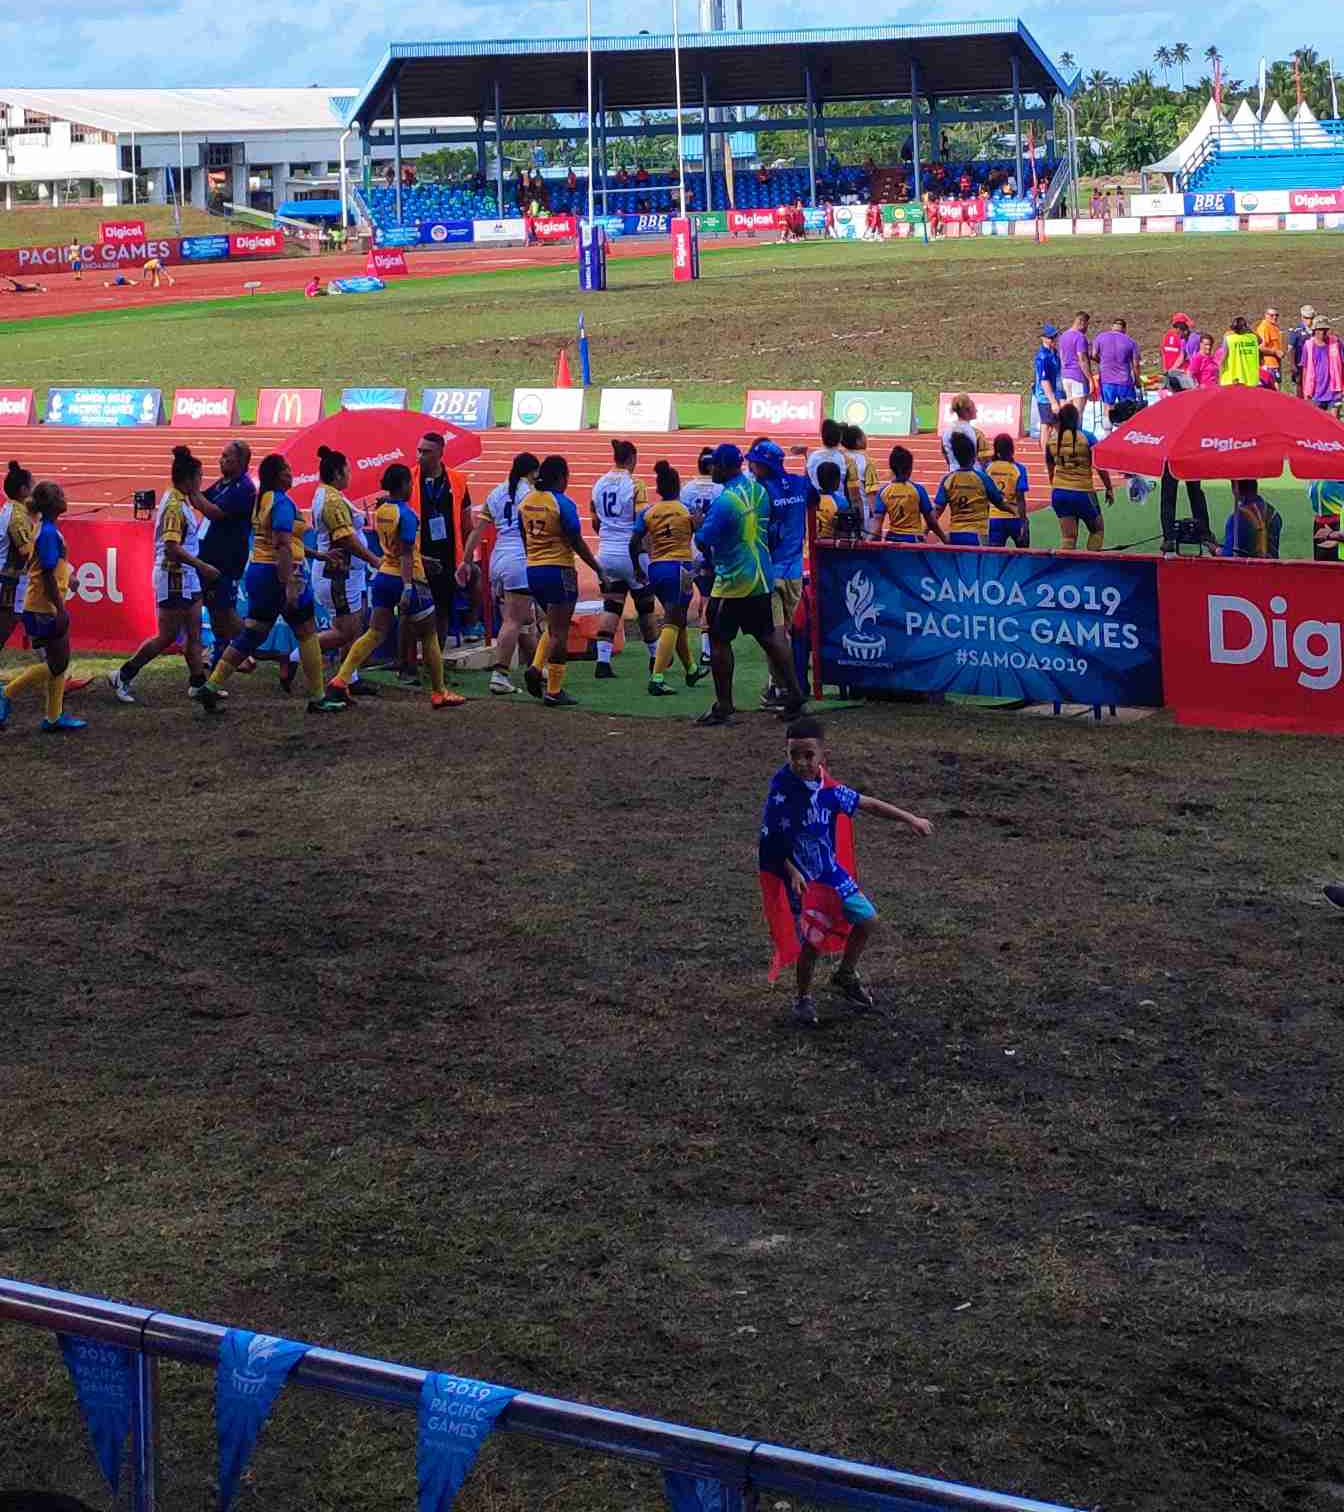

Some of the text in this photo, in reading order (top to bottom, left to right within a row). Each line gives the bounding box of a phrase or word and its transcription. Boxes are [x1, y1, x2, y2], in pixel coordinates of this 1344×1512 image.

[1194, 194, 1224, 211] BBE
[1294, 194, 1337, 208] Digicel
[735, 212, 774, 227] Digicel
[105, 224, 144, 240] Digicel
[236, 235, 276, 250] Digicel
[102, 241, 171, 261] GAMES
[375, 254, 404, 269] Digicel
[176, 396, 228, 417] Digicel
[432, 391, 482, 415] BBE
[751, 398, 814, 423] Digicel
[1200, 436, 1257, 452] Digicel
[920, 576, 1122, 616] SAMOA 2019
[905, 611, 1140, 650] PACIFIC GAMES
[956, 648, 1088, 676] #SAMOA2019
[442, 1380, 491, 1401] 2019
[430, 1397, 489, 1421] PACIFIC
[427, 1416, 478, 1439] GAMES
